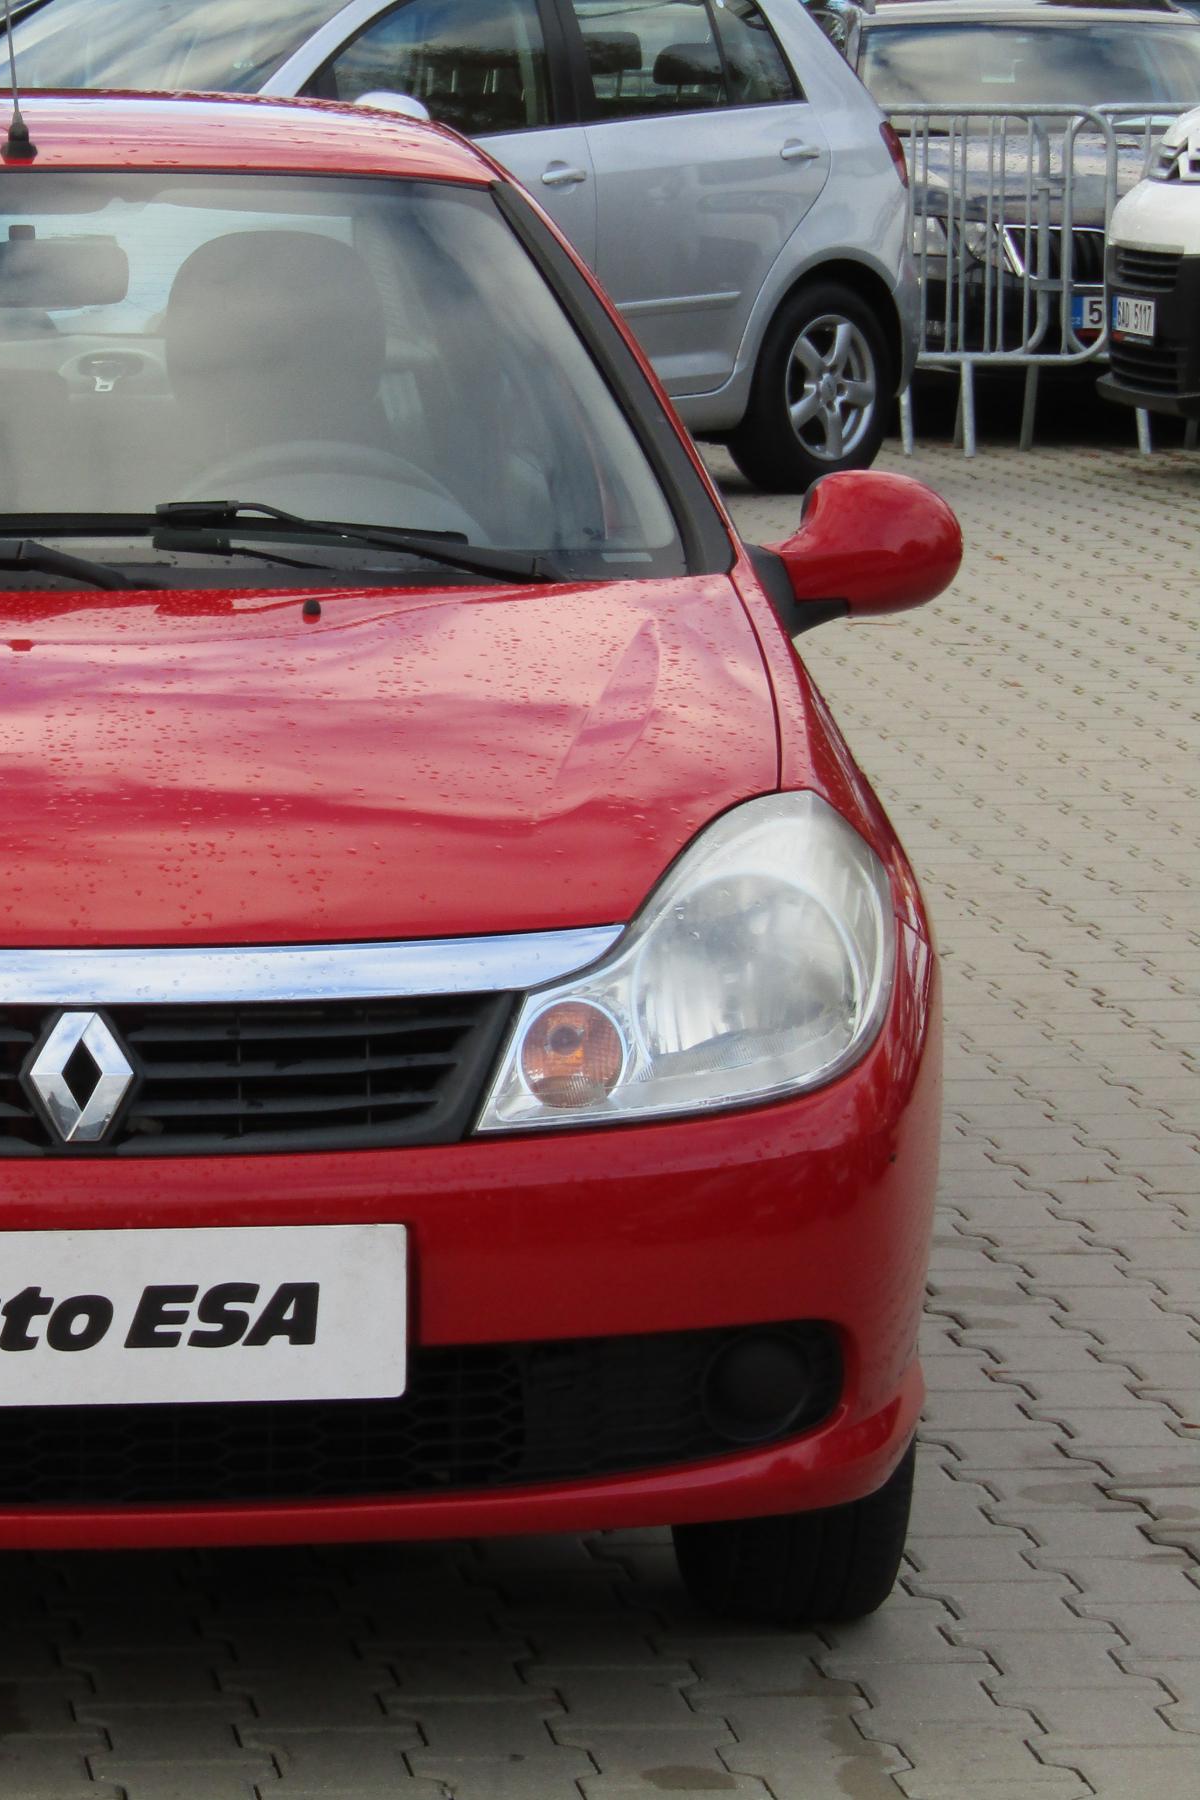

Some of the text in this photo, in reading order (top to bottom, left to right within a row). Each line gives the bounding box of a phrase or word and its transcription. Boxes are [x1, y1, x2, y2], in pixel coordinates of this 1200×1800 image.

[1088, 300, 1103, 325] 5
[1134, 303, 1152, 332] 5117
[123, 1282, 320, 1349] ESA
